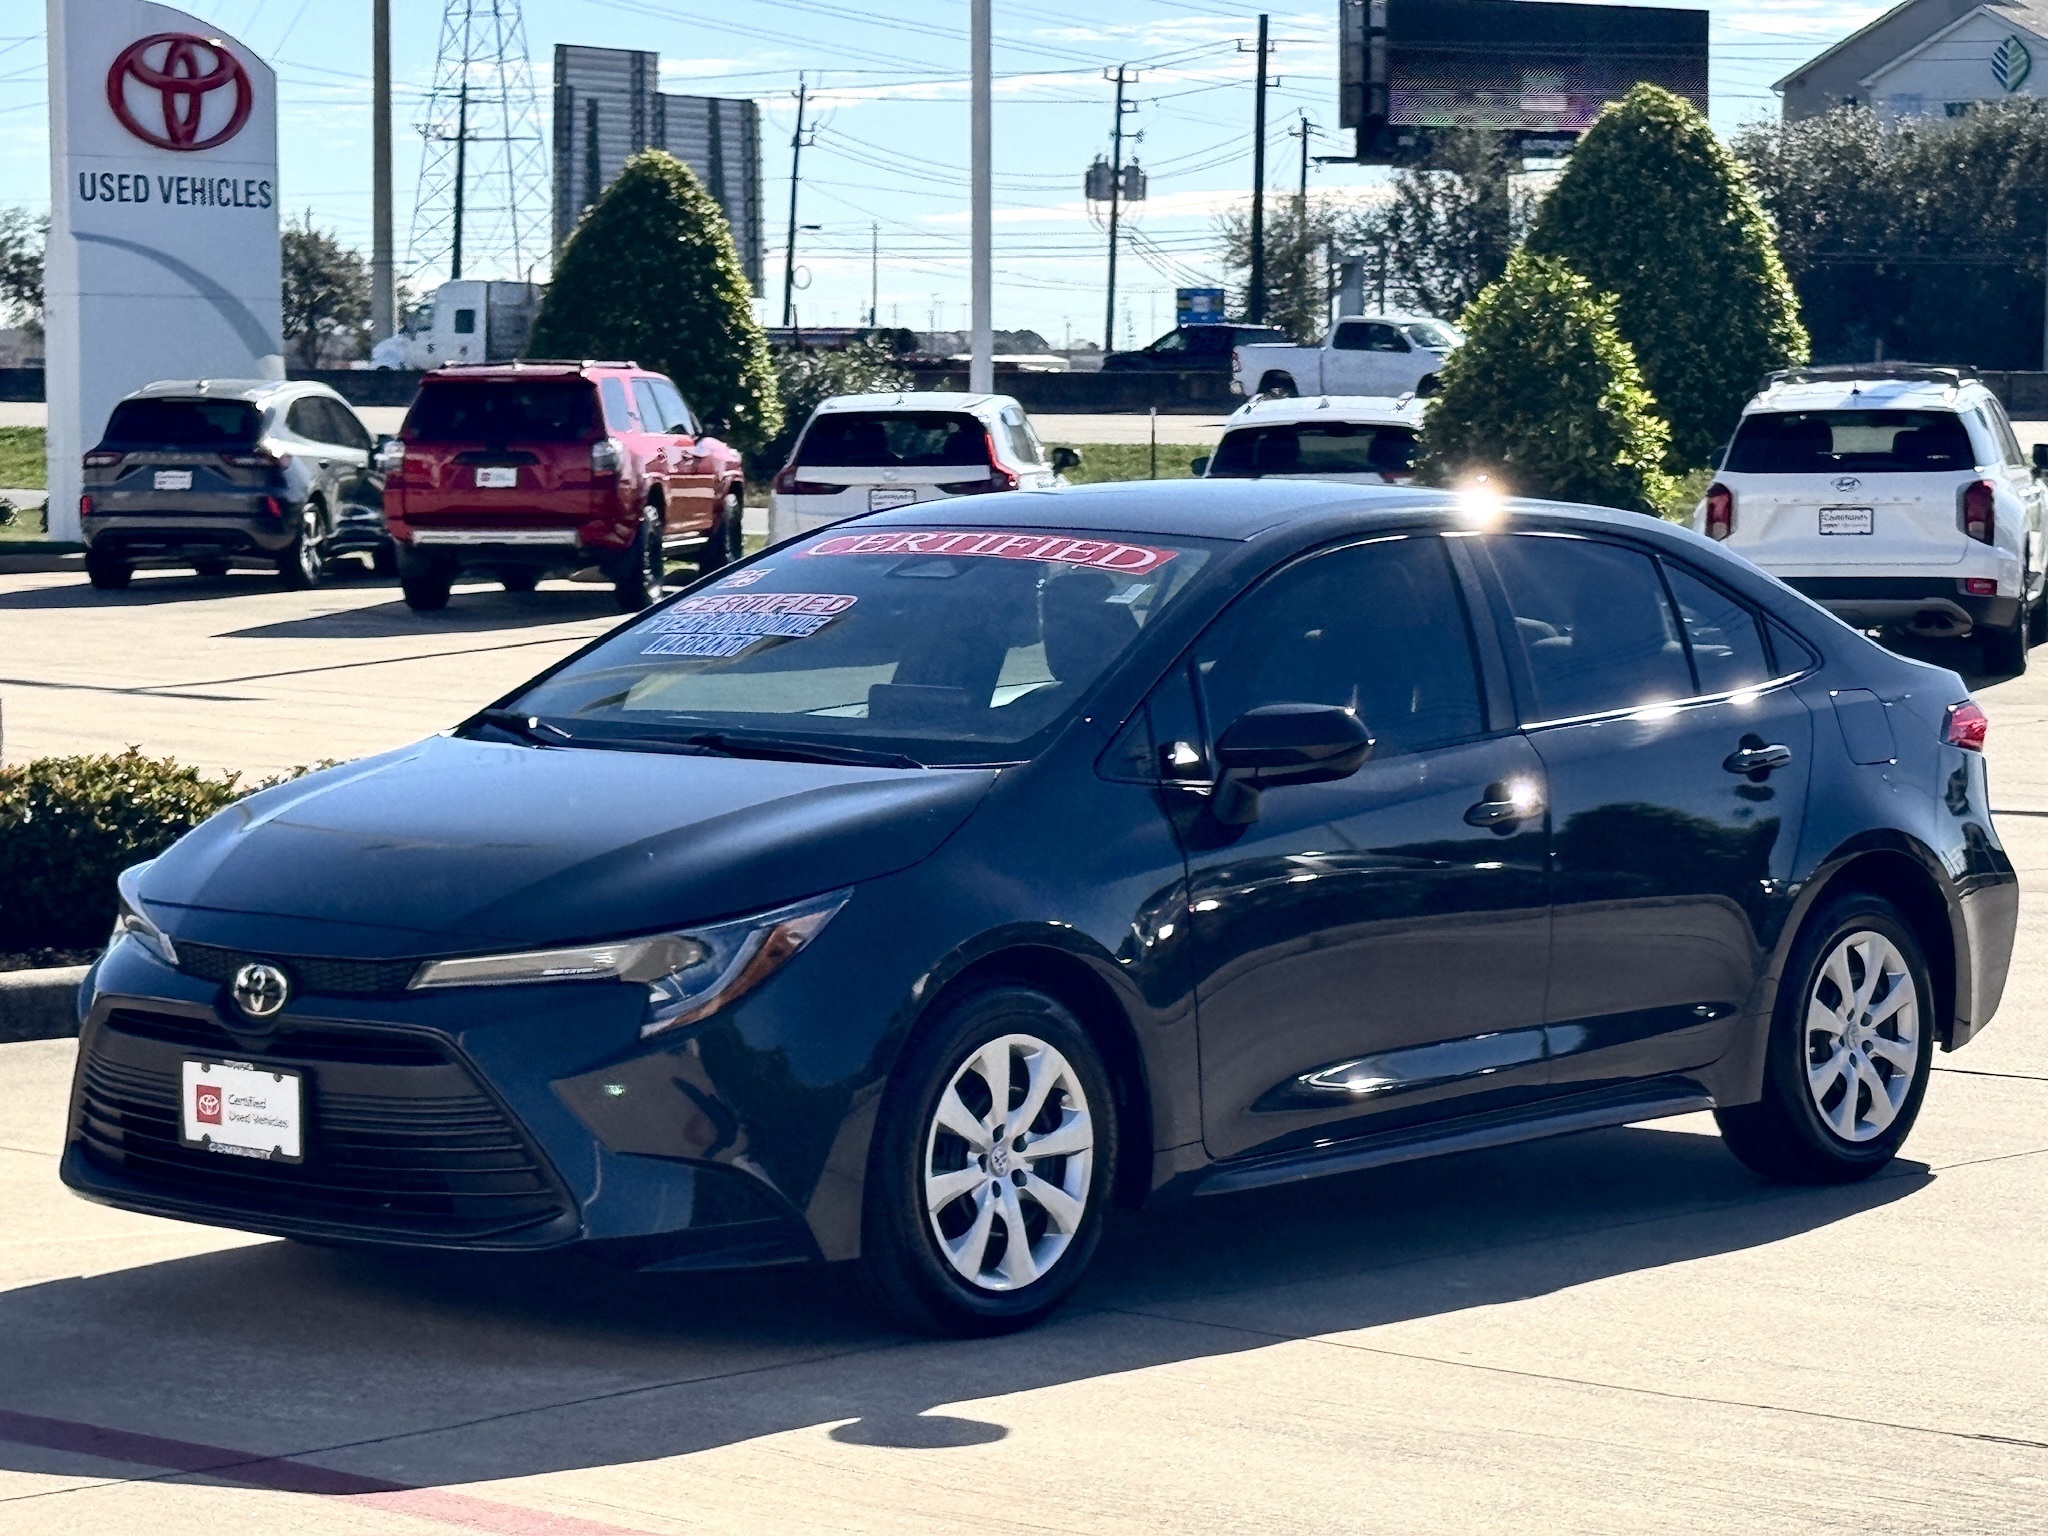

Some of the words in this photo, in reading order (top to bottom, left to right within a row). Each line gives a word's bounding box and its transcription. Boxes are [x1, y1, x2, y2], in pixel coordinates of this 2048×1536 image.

[79, 172, 150, 202] USED
[157, 175, 273, 209] VEHICLES
[807, 532, 1157, 568] CERTIFIED
[671, 595, 856, 613] CERTIFIED
[641, 634, 763, 656] WARRANTY
